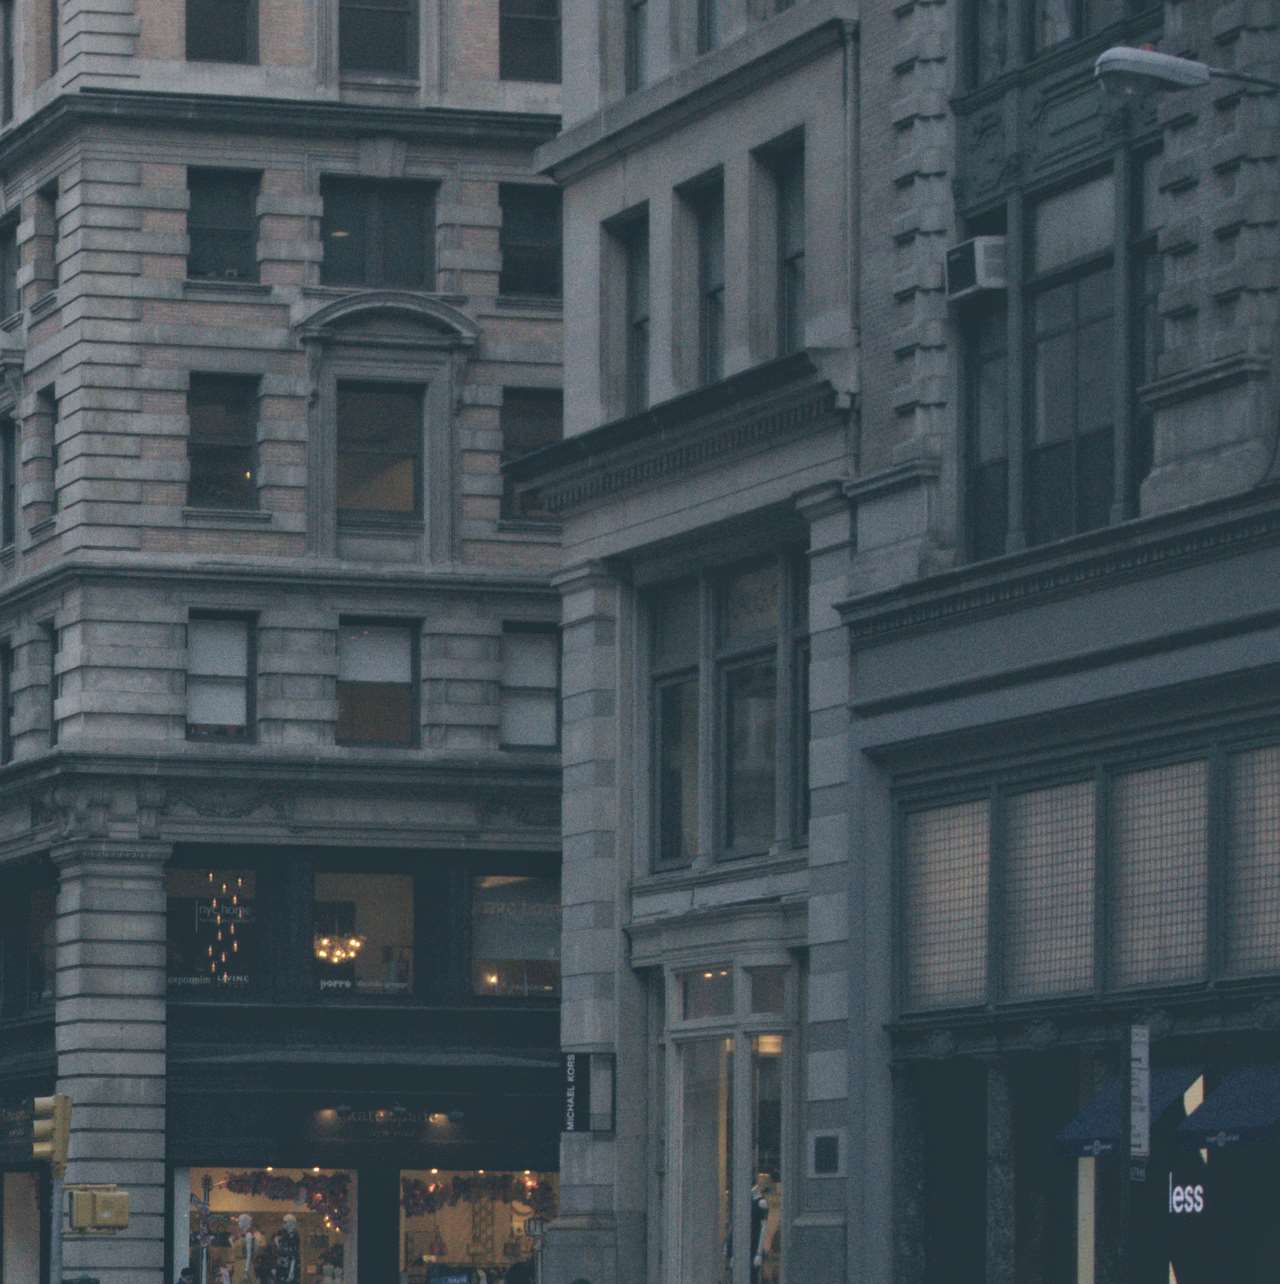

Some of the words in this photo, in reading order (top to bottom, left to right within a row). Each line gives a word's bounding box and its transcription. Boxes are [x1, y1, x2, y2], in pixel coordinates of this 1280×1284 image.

[566, 1054, 575, 1082] KORS
[566, 1084, 575, 1131] MICHAEL
[1169, 1171, 1204, 1213] less
